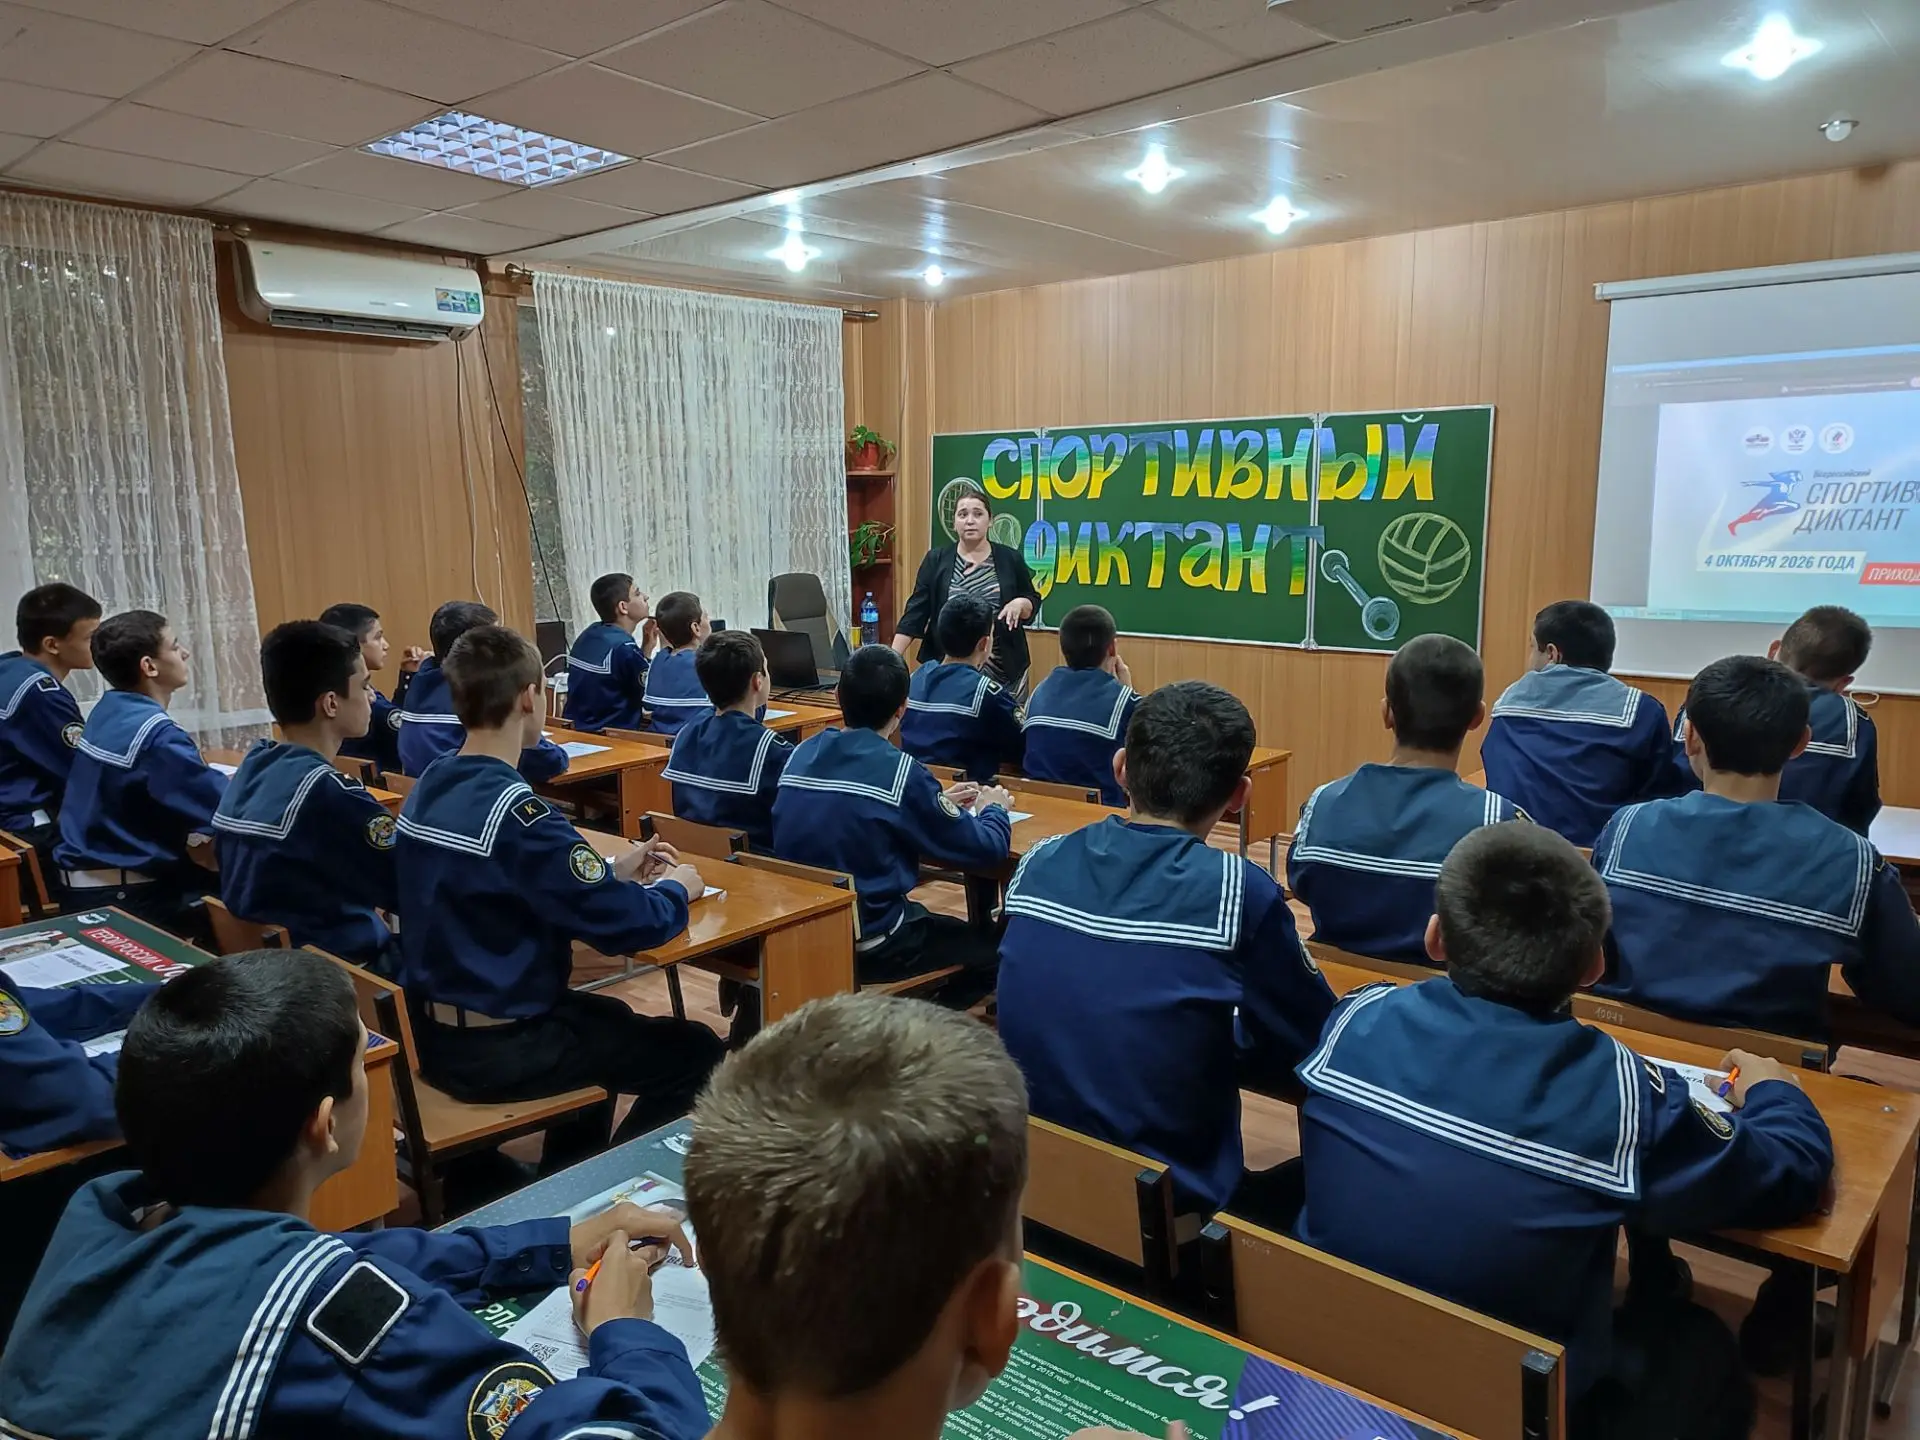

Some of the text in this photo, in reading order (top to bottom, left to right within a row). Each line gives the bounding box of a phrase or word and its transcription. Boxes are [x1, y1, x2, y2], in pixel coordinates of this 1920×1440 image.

[981, 414, 1440, 500] СПОРТИВНЫЙ
[1793, 507, 1909, 535] ДИКТАНТ
[1704, 554, 1855, 570] 4 ОКТЯБРЯ 2026 ГОДА
[86, 928, 124, 949] ГЕРОЙ
[120, 941, 162, 965] РОССИИ
[1036, 1365, 1055, 1378] 2015
[1061, 1393, 1093, 1412] попадал
[1104, 1388, 1125, 1403] Когда
[1125, 1400, 1160, 1420] мальчику
